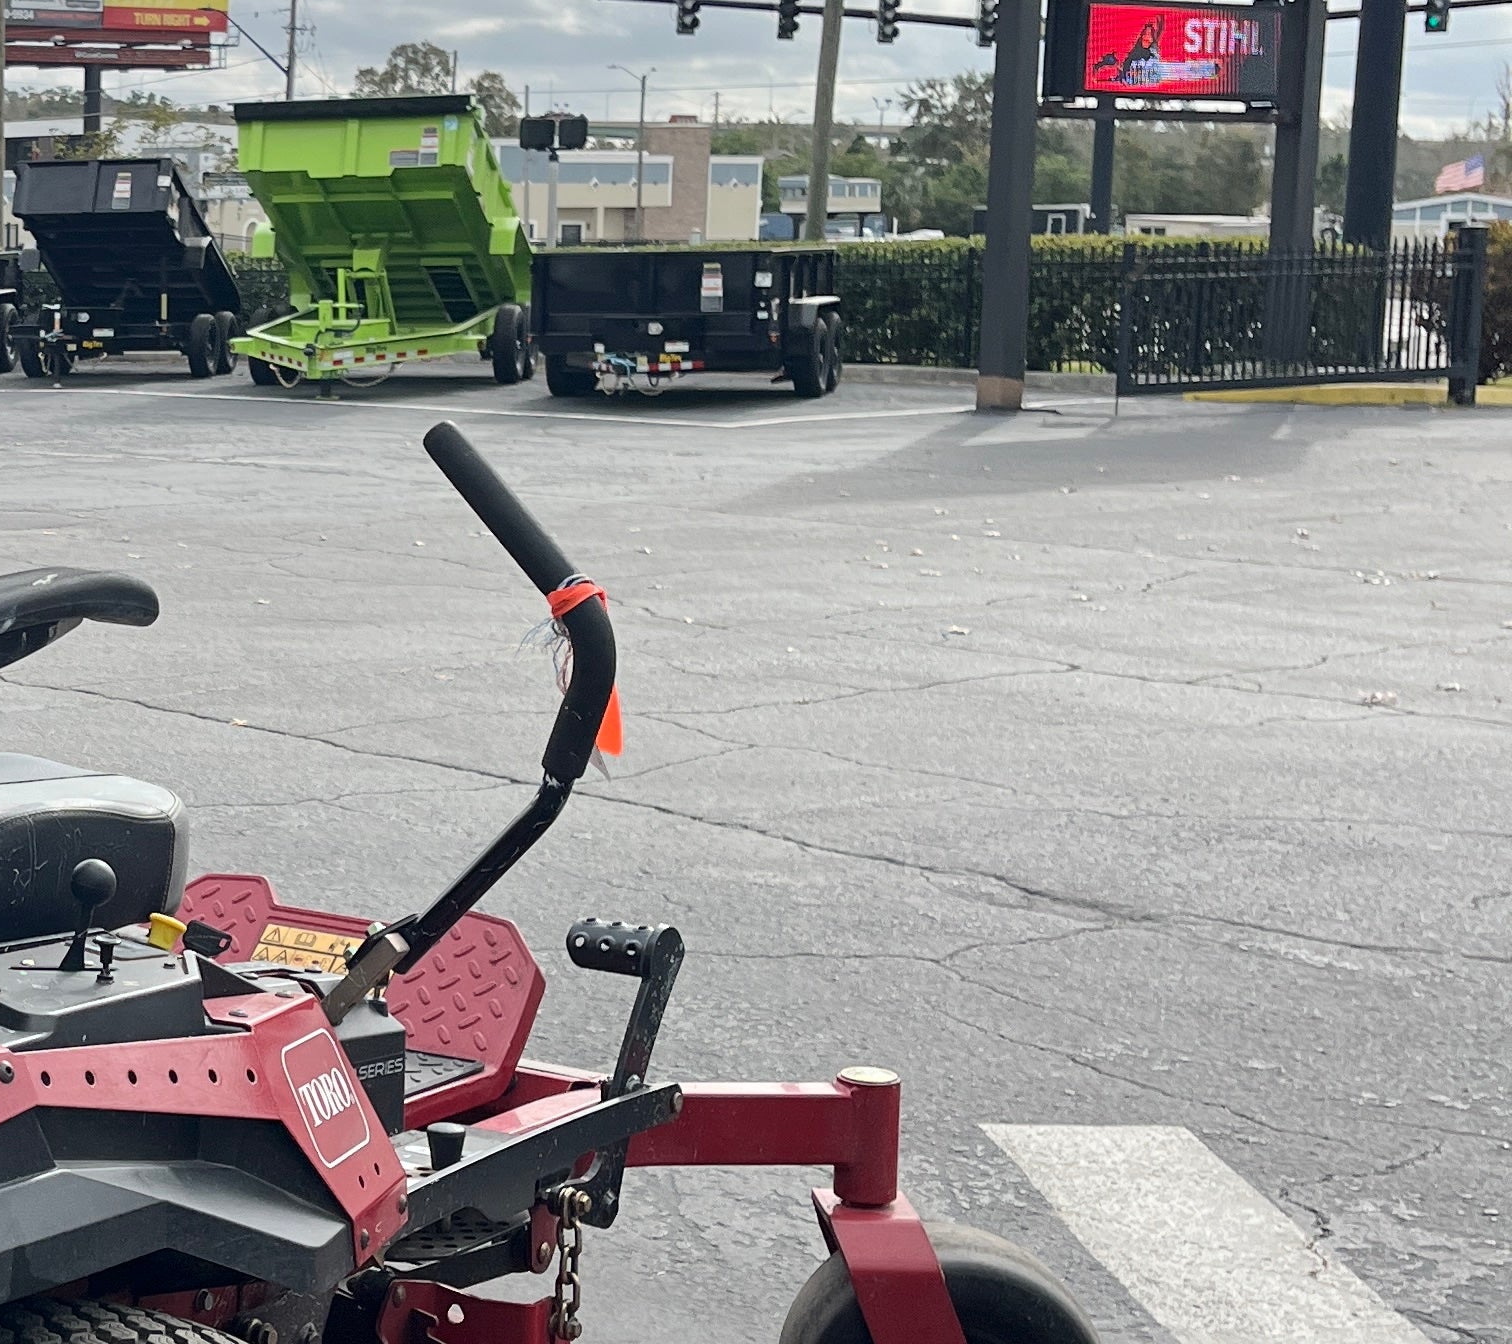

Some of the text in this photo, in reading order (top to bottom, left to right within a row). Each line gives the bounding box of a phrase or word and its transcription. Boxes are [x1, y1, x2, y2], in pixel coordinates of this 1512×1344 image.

[134, 12, 191, 27] TURN RIGHT
[1184, 18, 1263, 56] STIHL
[358, 1057, 404, 1081] SERIES
[298, 1067, 351, 1128] TORO
